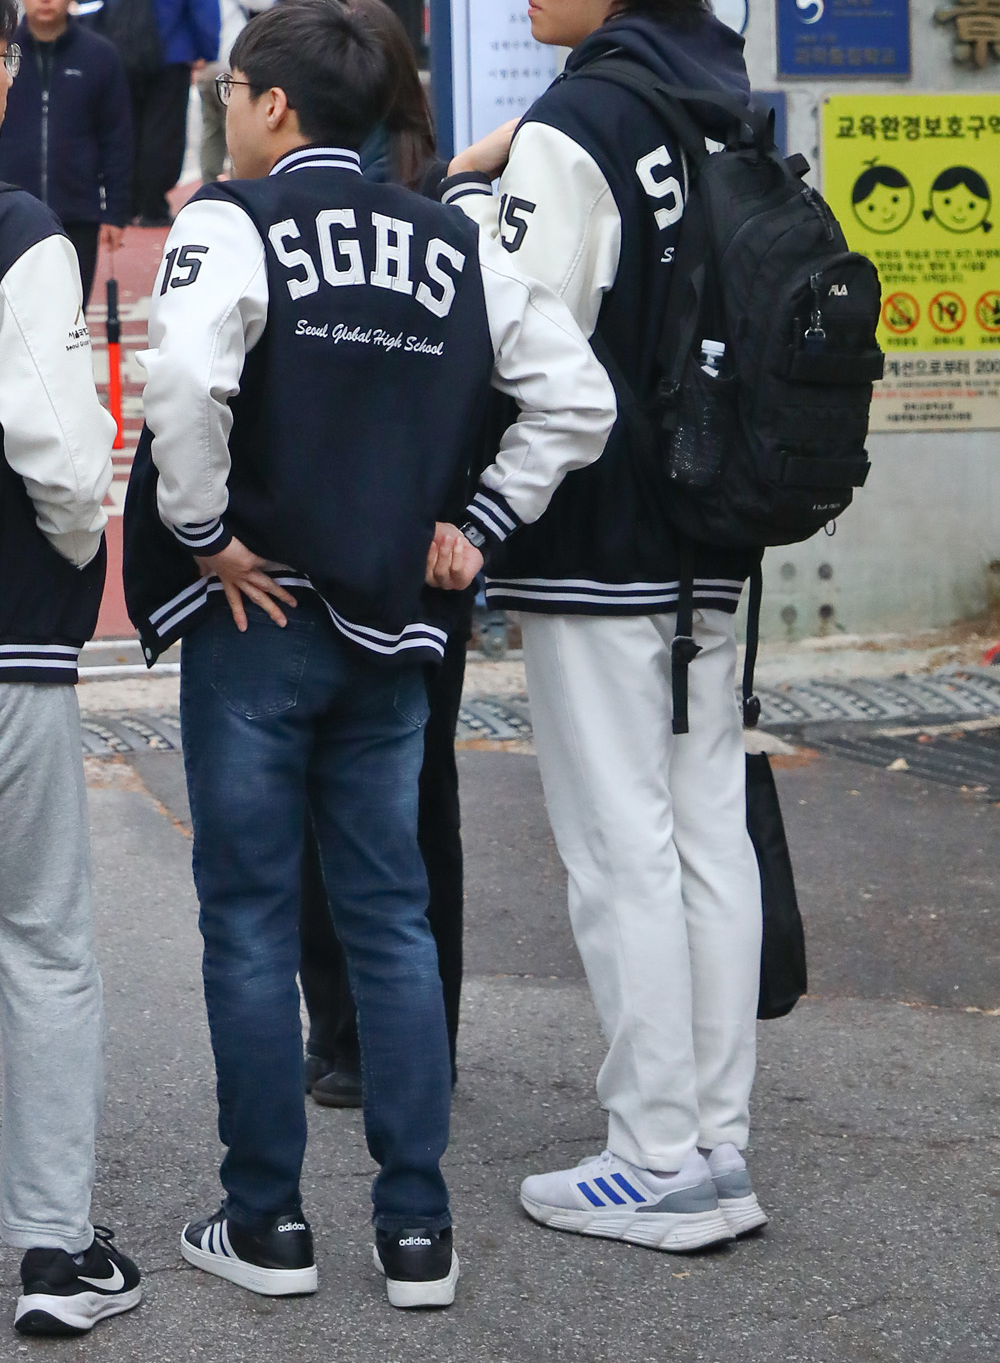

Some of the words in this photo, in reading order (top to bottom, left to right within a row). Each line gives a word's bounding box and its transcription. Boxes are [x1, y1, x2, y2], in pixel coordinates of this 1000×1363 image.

[499, 193, 537, 253] 15
[160, 244, 209, 297] 15
[267, 208, 466, 319] SGHS
[295, 319, 329, 339] Seoul
[331, 323, 372, 344] Global
[373, 329, 403, 353] High
[403, 336, 444, 357] School
[883, 358, 970, 377] 계선으로부터
[278, 1221, 306, 1233] adidas
[399, 1236, 432, 1247] adidas
